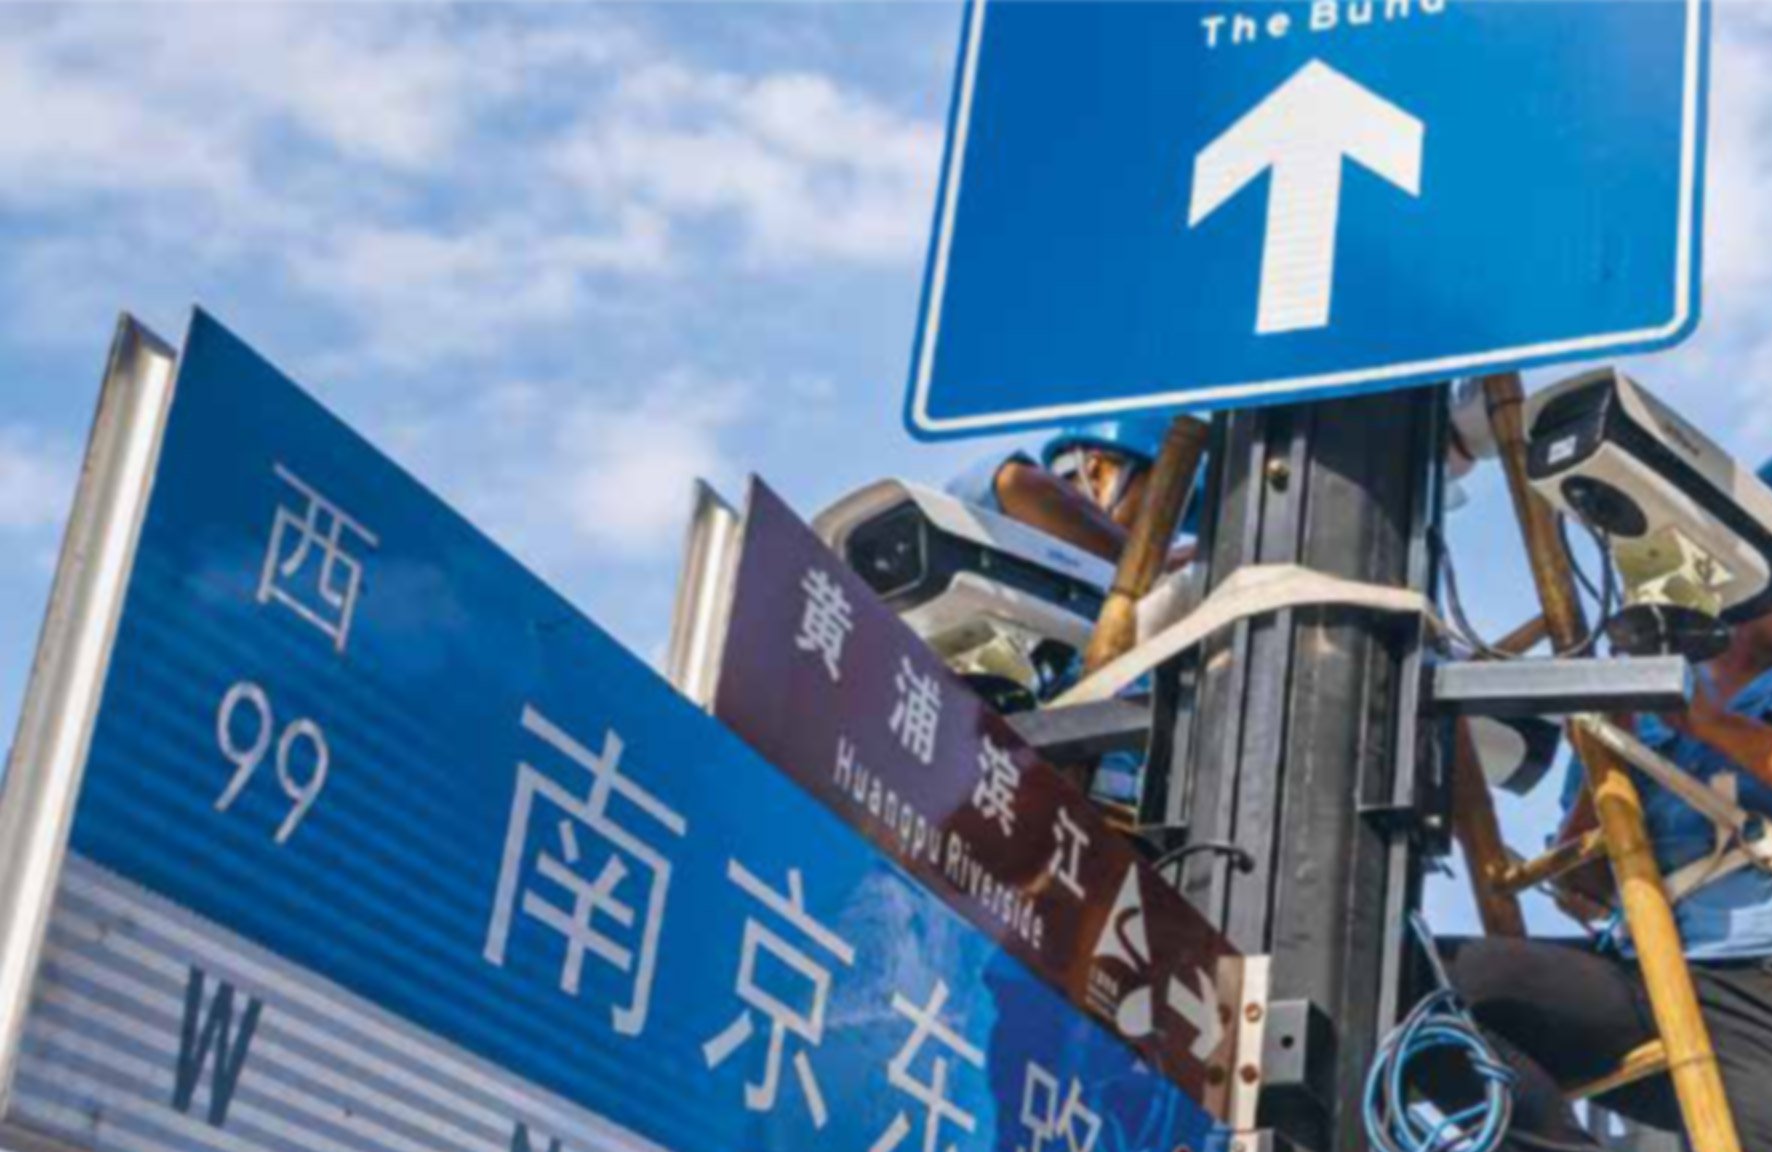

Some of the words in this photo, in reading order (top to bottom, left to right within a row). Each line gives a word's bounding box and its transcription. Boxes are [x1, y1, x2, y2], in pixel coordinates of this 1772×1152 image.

[1200, 12, 1290, 48] The
[257, 461, 381, 654] 西
[215, 681, 330, 846] 99
[796, 567, 1090, 899] 黄浦滨江
[834, 735, 942, 864] Huangpu
[945, 831, 1044, 949] Riverside
[171, 963, 265, 1130] W
